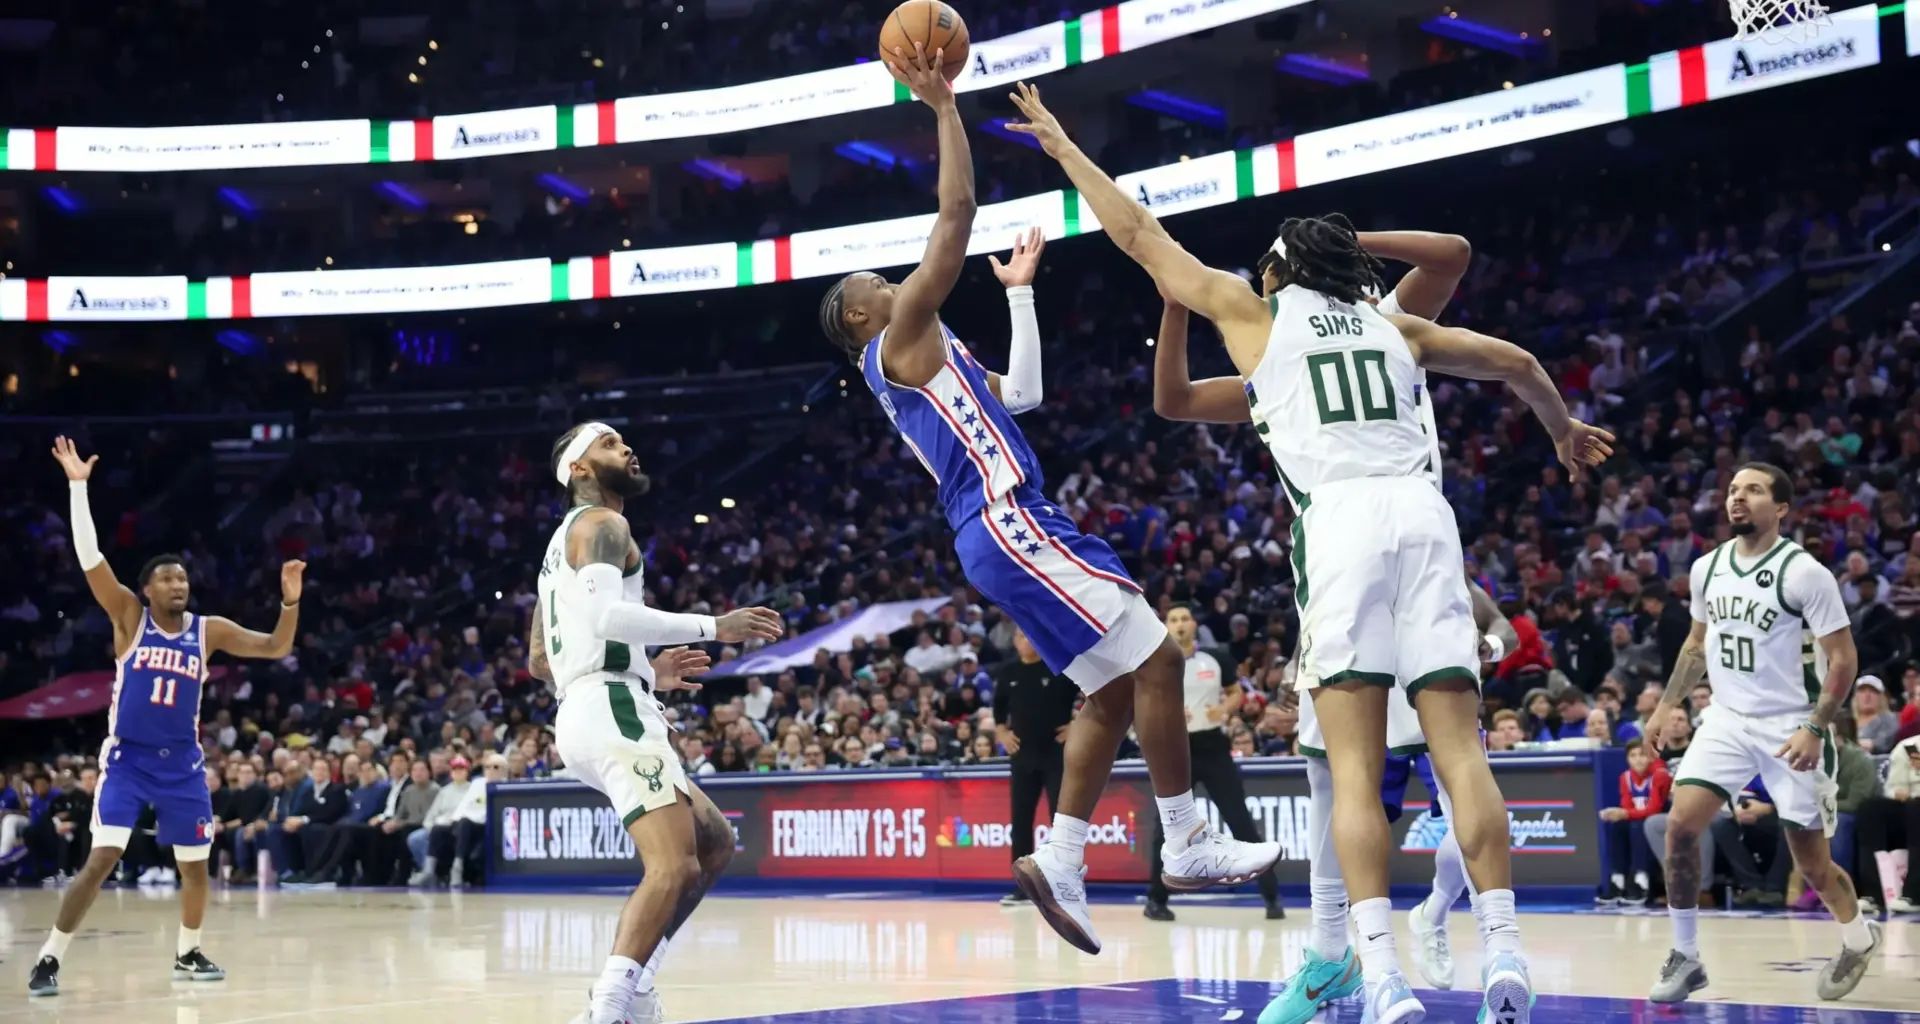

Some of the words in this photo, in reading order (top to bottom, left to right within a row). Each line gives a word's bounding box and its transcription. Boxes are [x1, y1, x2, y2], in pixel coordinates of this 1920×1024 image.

[1729, 38, 1856, 82] Amoroso's
[1308, 314, 1363, 337] SIMS
[1306, 350, 1398, 425] 00
[1707, 596, 1778, 633] BUCKS
[132, 646, 200, 679] PHILA
[1719, 633, 1755, 673] 50
[150, 676, 177, 706] 11
[518, 808, 547, 859] ALL
[549, 807, 593, 859] STAR
[772, 809, 871, 857] FEBRUARY
[872, 808, 926, 858] 13-15
[1034, 815, 1128, 851] pock
[1507, 812, 1567, 847] ngeles
